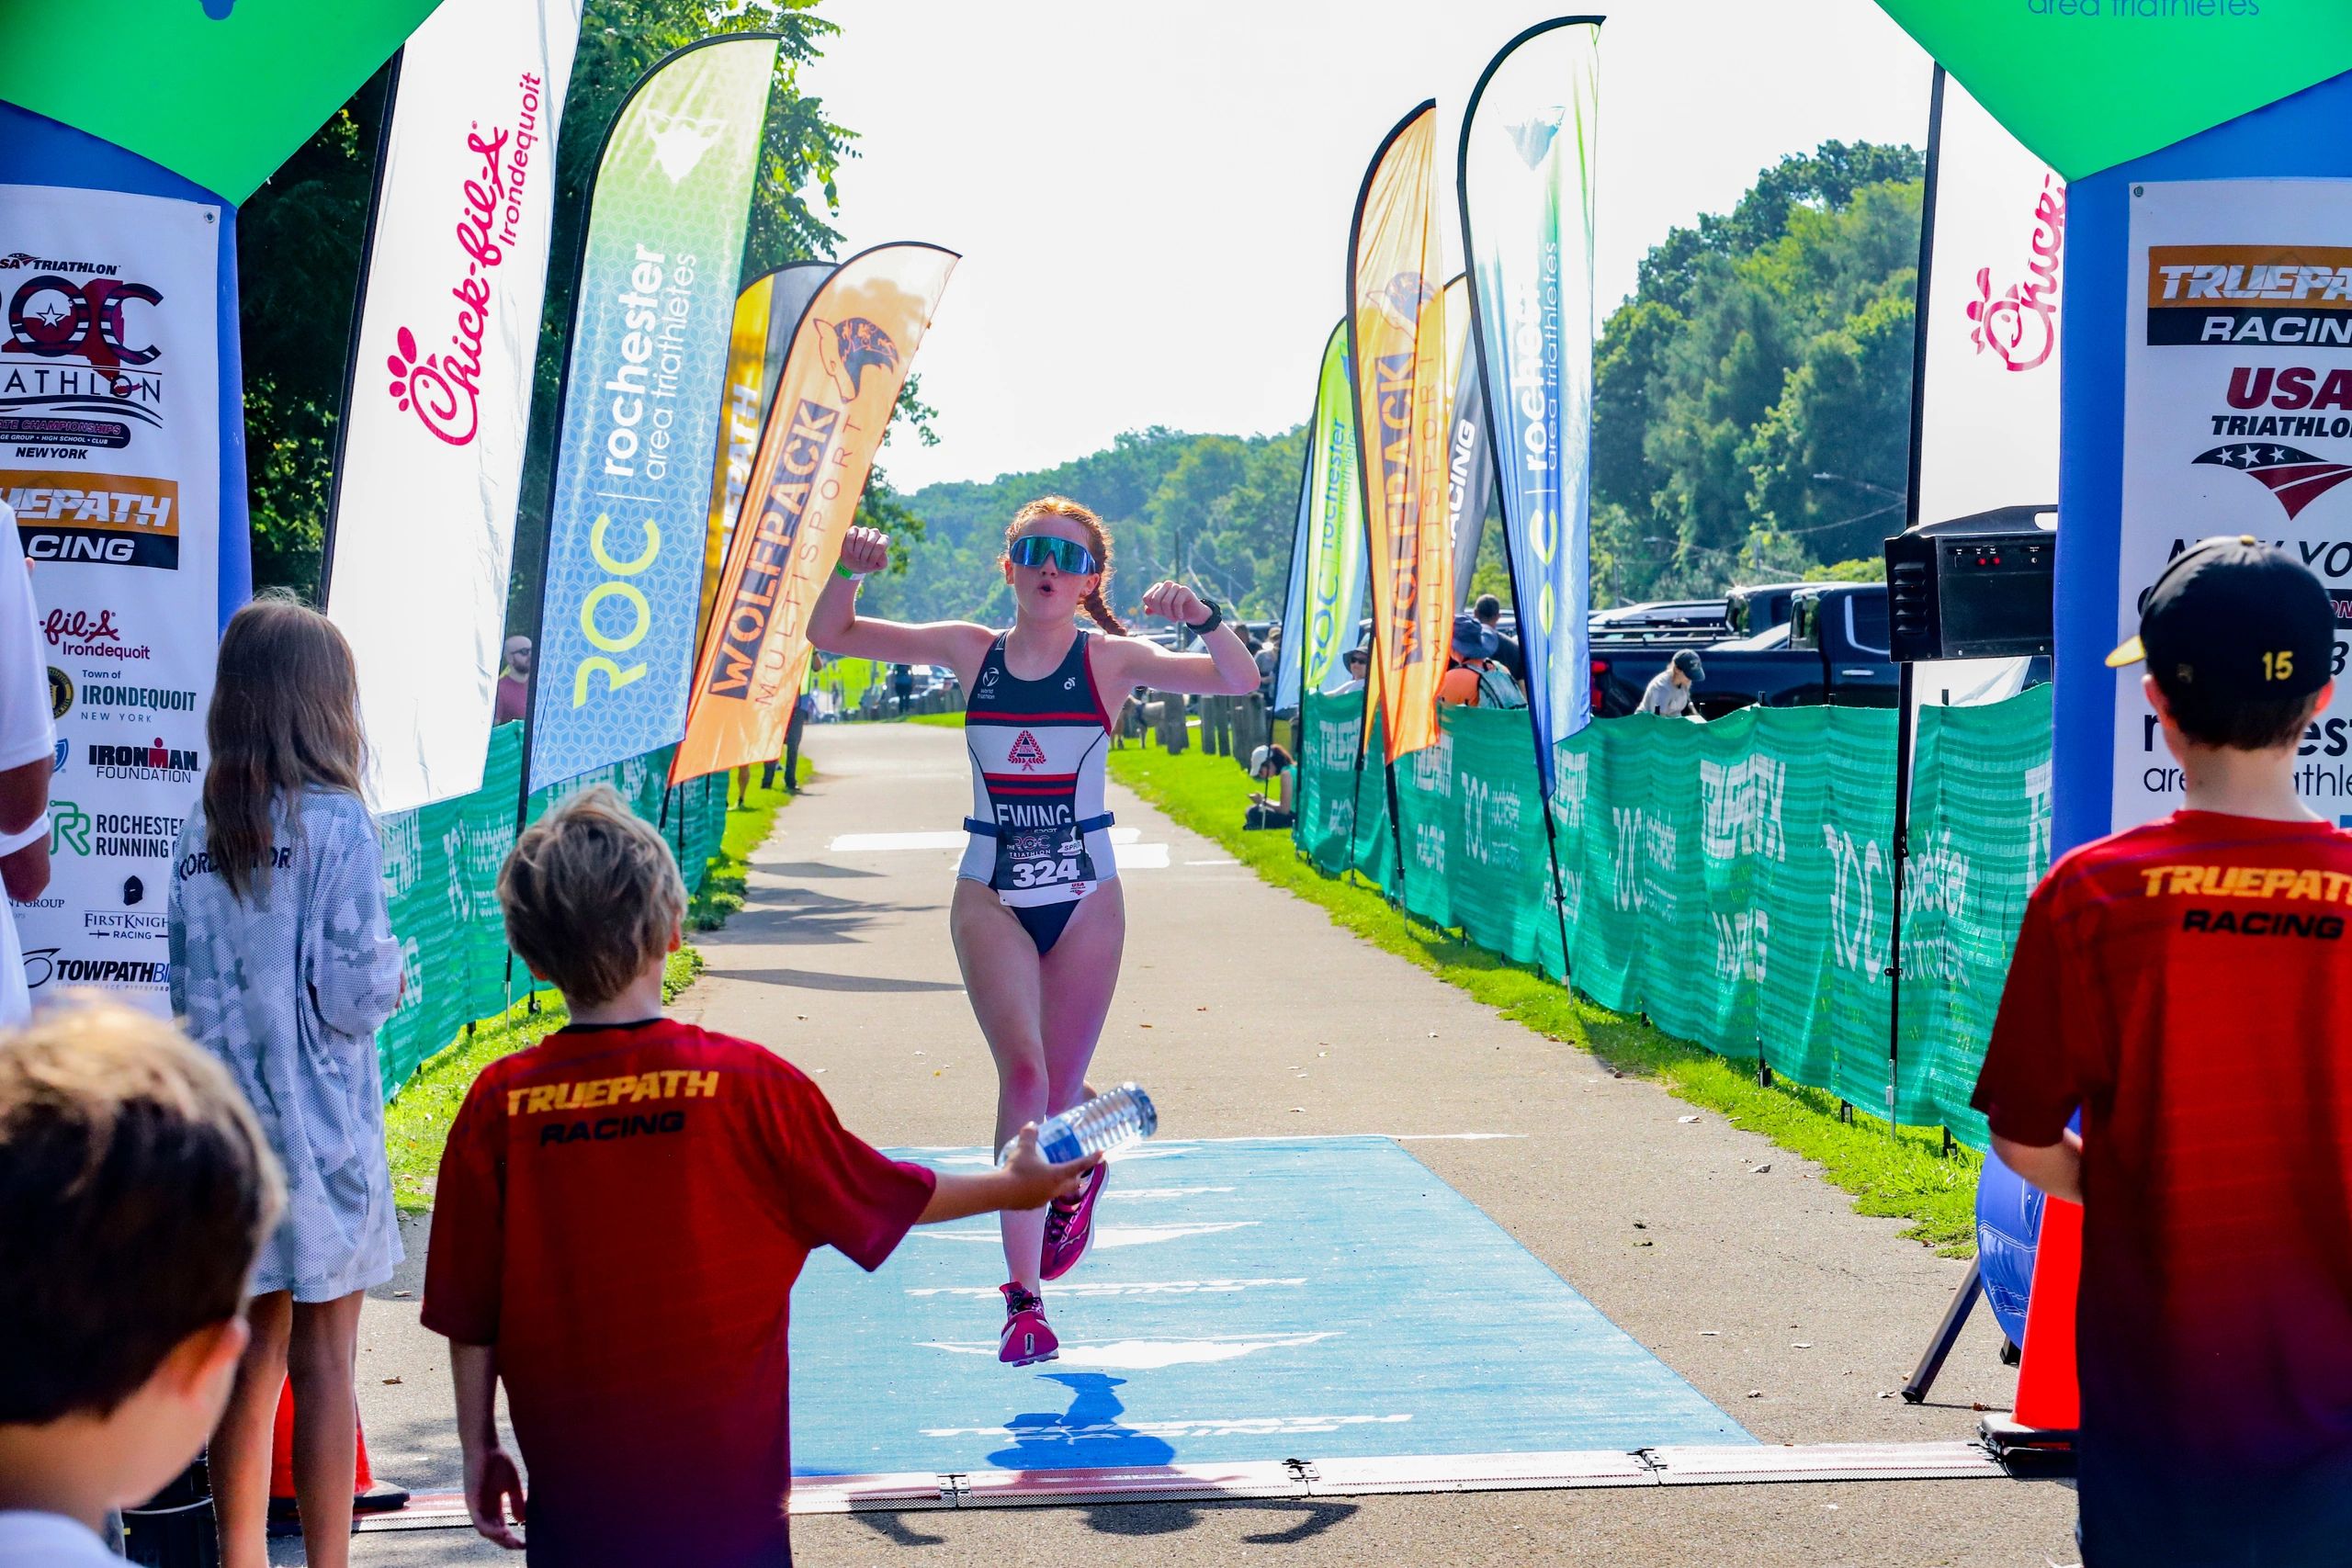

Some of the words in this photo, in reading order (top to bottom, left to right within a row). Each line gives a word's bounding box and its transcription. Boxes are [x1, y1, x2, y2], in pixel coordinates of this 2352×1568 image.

[499, 72, 541, 247] Irondequoit
[33, 259, 118, 276] TRIATHLON
[654, 253, 698, 404] triathletes
[1543, 242, 1558, 387] triathletes
[602, 243, 665, 478] rochester
[2225, 367, 2352, 411] USA
[21, 420, 122, 434] CHAMPIONSHIPS
[1545, 398, 1558, 471] area
[2211, 416, 2352, 437] TRIATHLO
[647, 409, 673, 481] area
[1322, 417, 1346, 549] rochester
[1376, 353, 1419, 671] WOLFPACK
[710, 401, 836, 695] WOLFPACK
[755, 413, 863, 705] MULTISPORT
[572, 512, 662, 710] ROC
[1310, 571, 1340, 679] ROC
[62, 641, 151, 660] Irondequoit
[2262, 649, 2294, 682] 15
[82, 669, 109, 679] Town
[111, 670, 122, 680] of
[82, 684, 197, 712] IRONDEQUOIT
[81, 712, 110, 720] NEW
[119, 713, 153, 723] YORK
[88, 737, 198, 772] IRONMAN
[96, 766, 191, 784] FOUNDATION
[96, 837, 169, 858] RUNNING
[1009, 850, 1051, 858] TRIATHLON
[1013, 834, 1051, 852] ROC
[1012, 858, 1080, 888] 324
[113, 931, 153, 940] RACING
[2181, 908, 2346, 940] RACING
[506, 1069, 719, 1117] TRUEPATH
[539, 1111, 686, 1147] RACING
